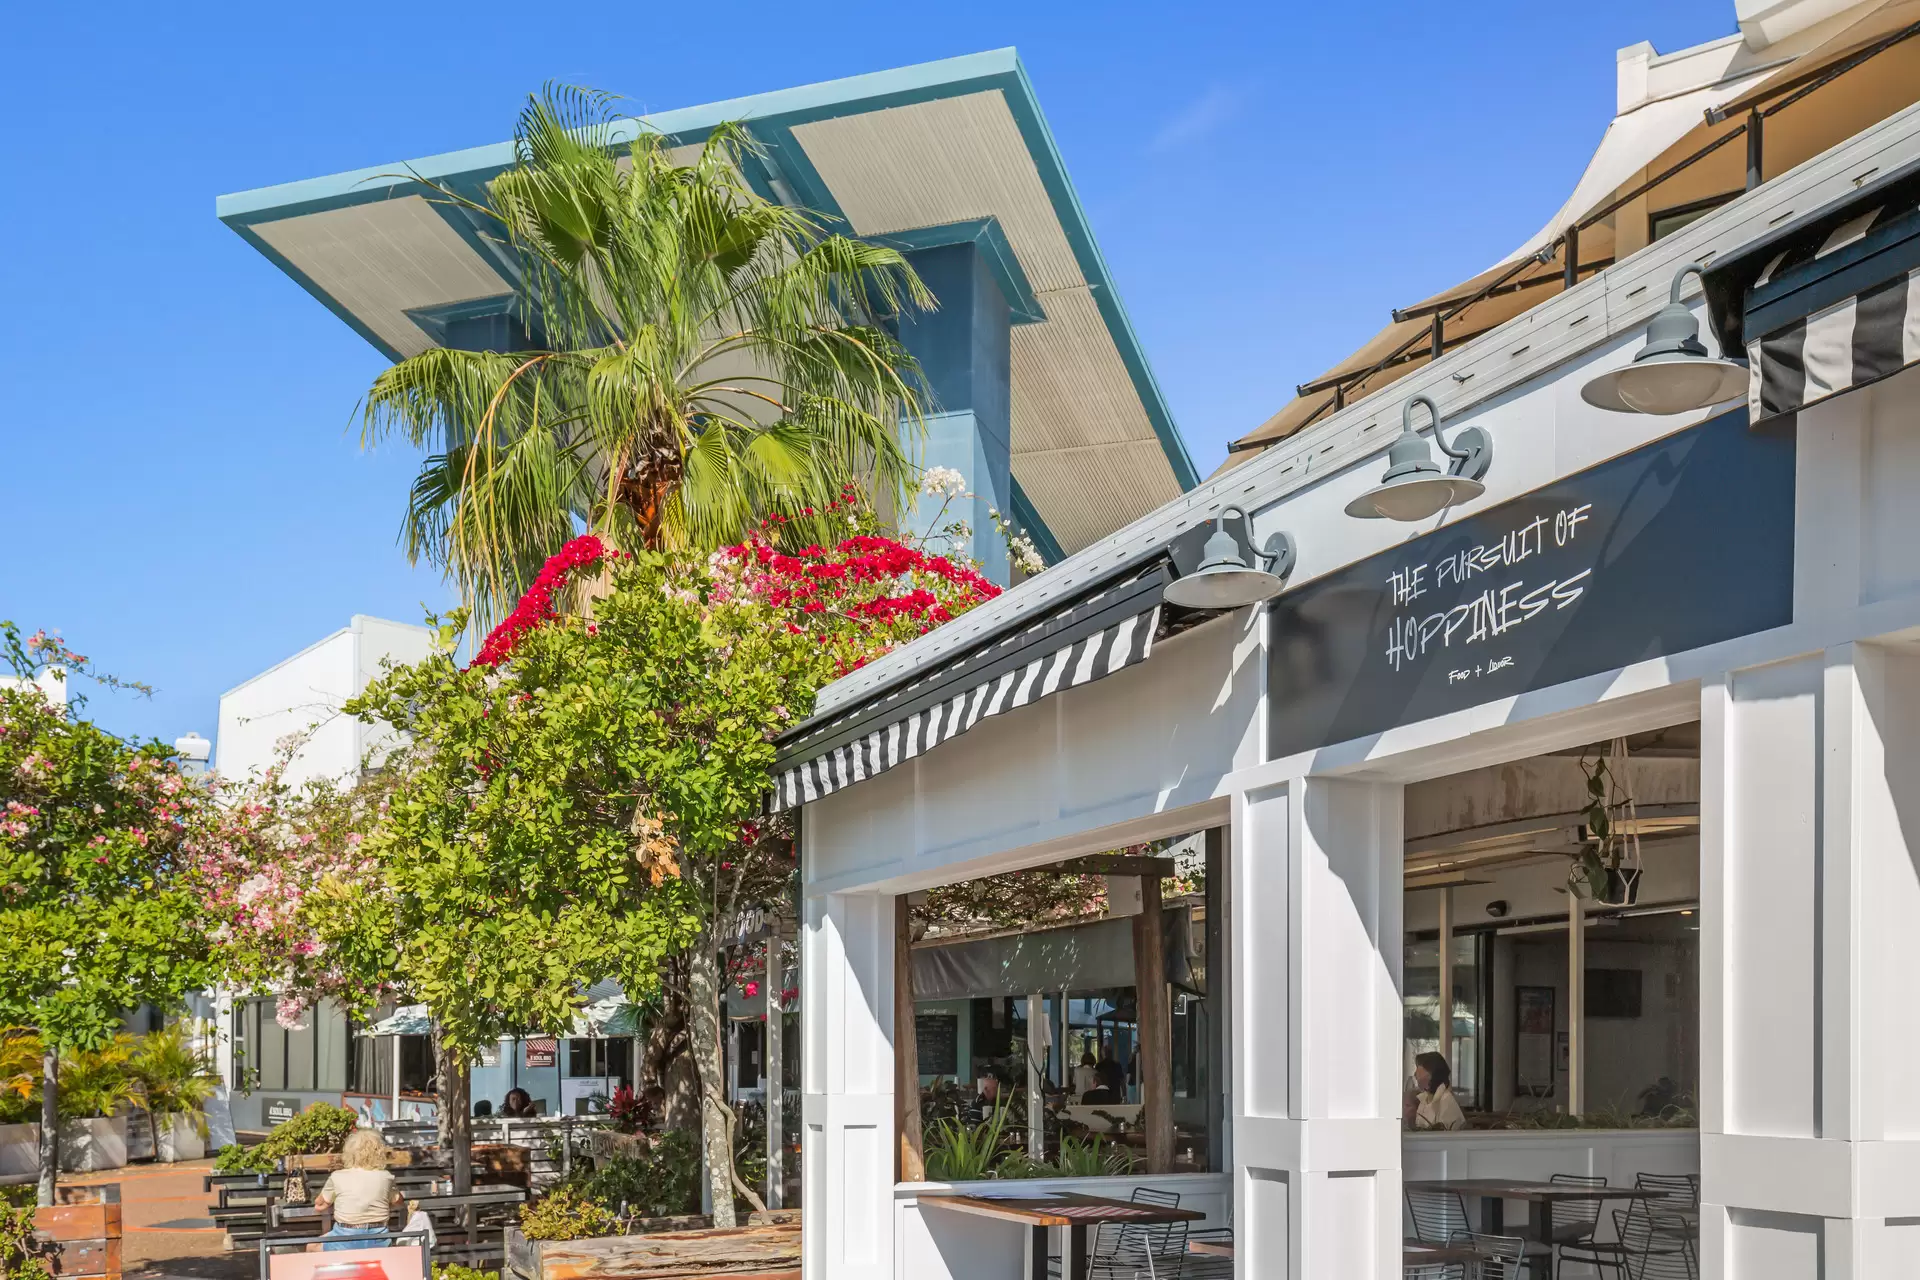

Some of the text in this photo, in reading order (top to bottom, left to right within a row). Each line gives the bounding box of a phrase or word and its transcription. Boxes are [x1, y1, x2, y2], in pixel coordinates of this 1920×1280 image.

[1385, 503, 1592, 607] THE PURSUIT OF
[1385, 567, 1592, 672] HOPPINESS
